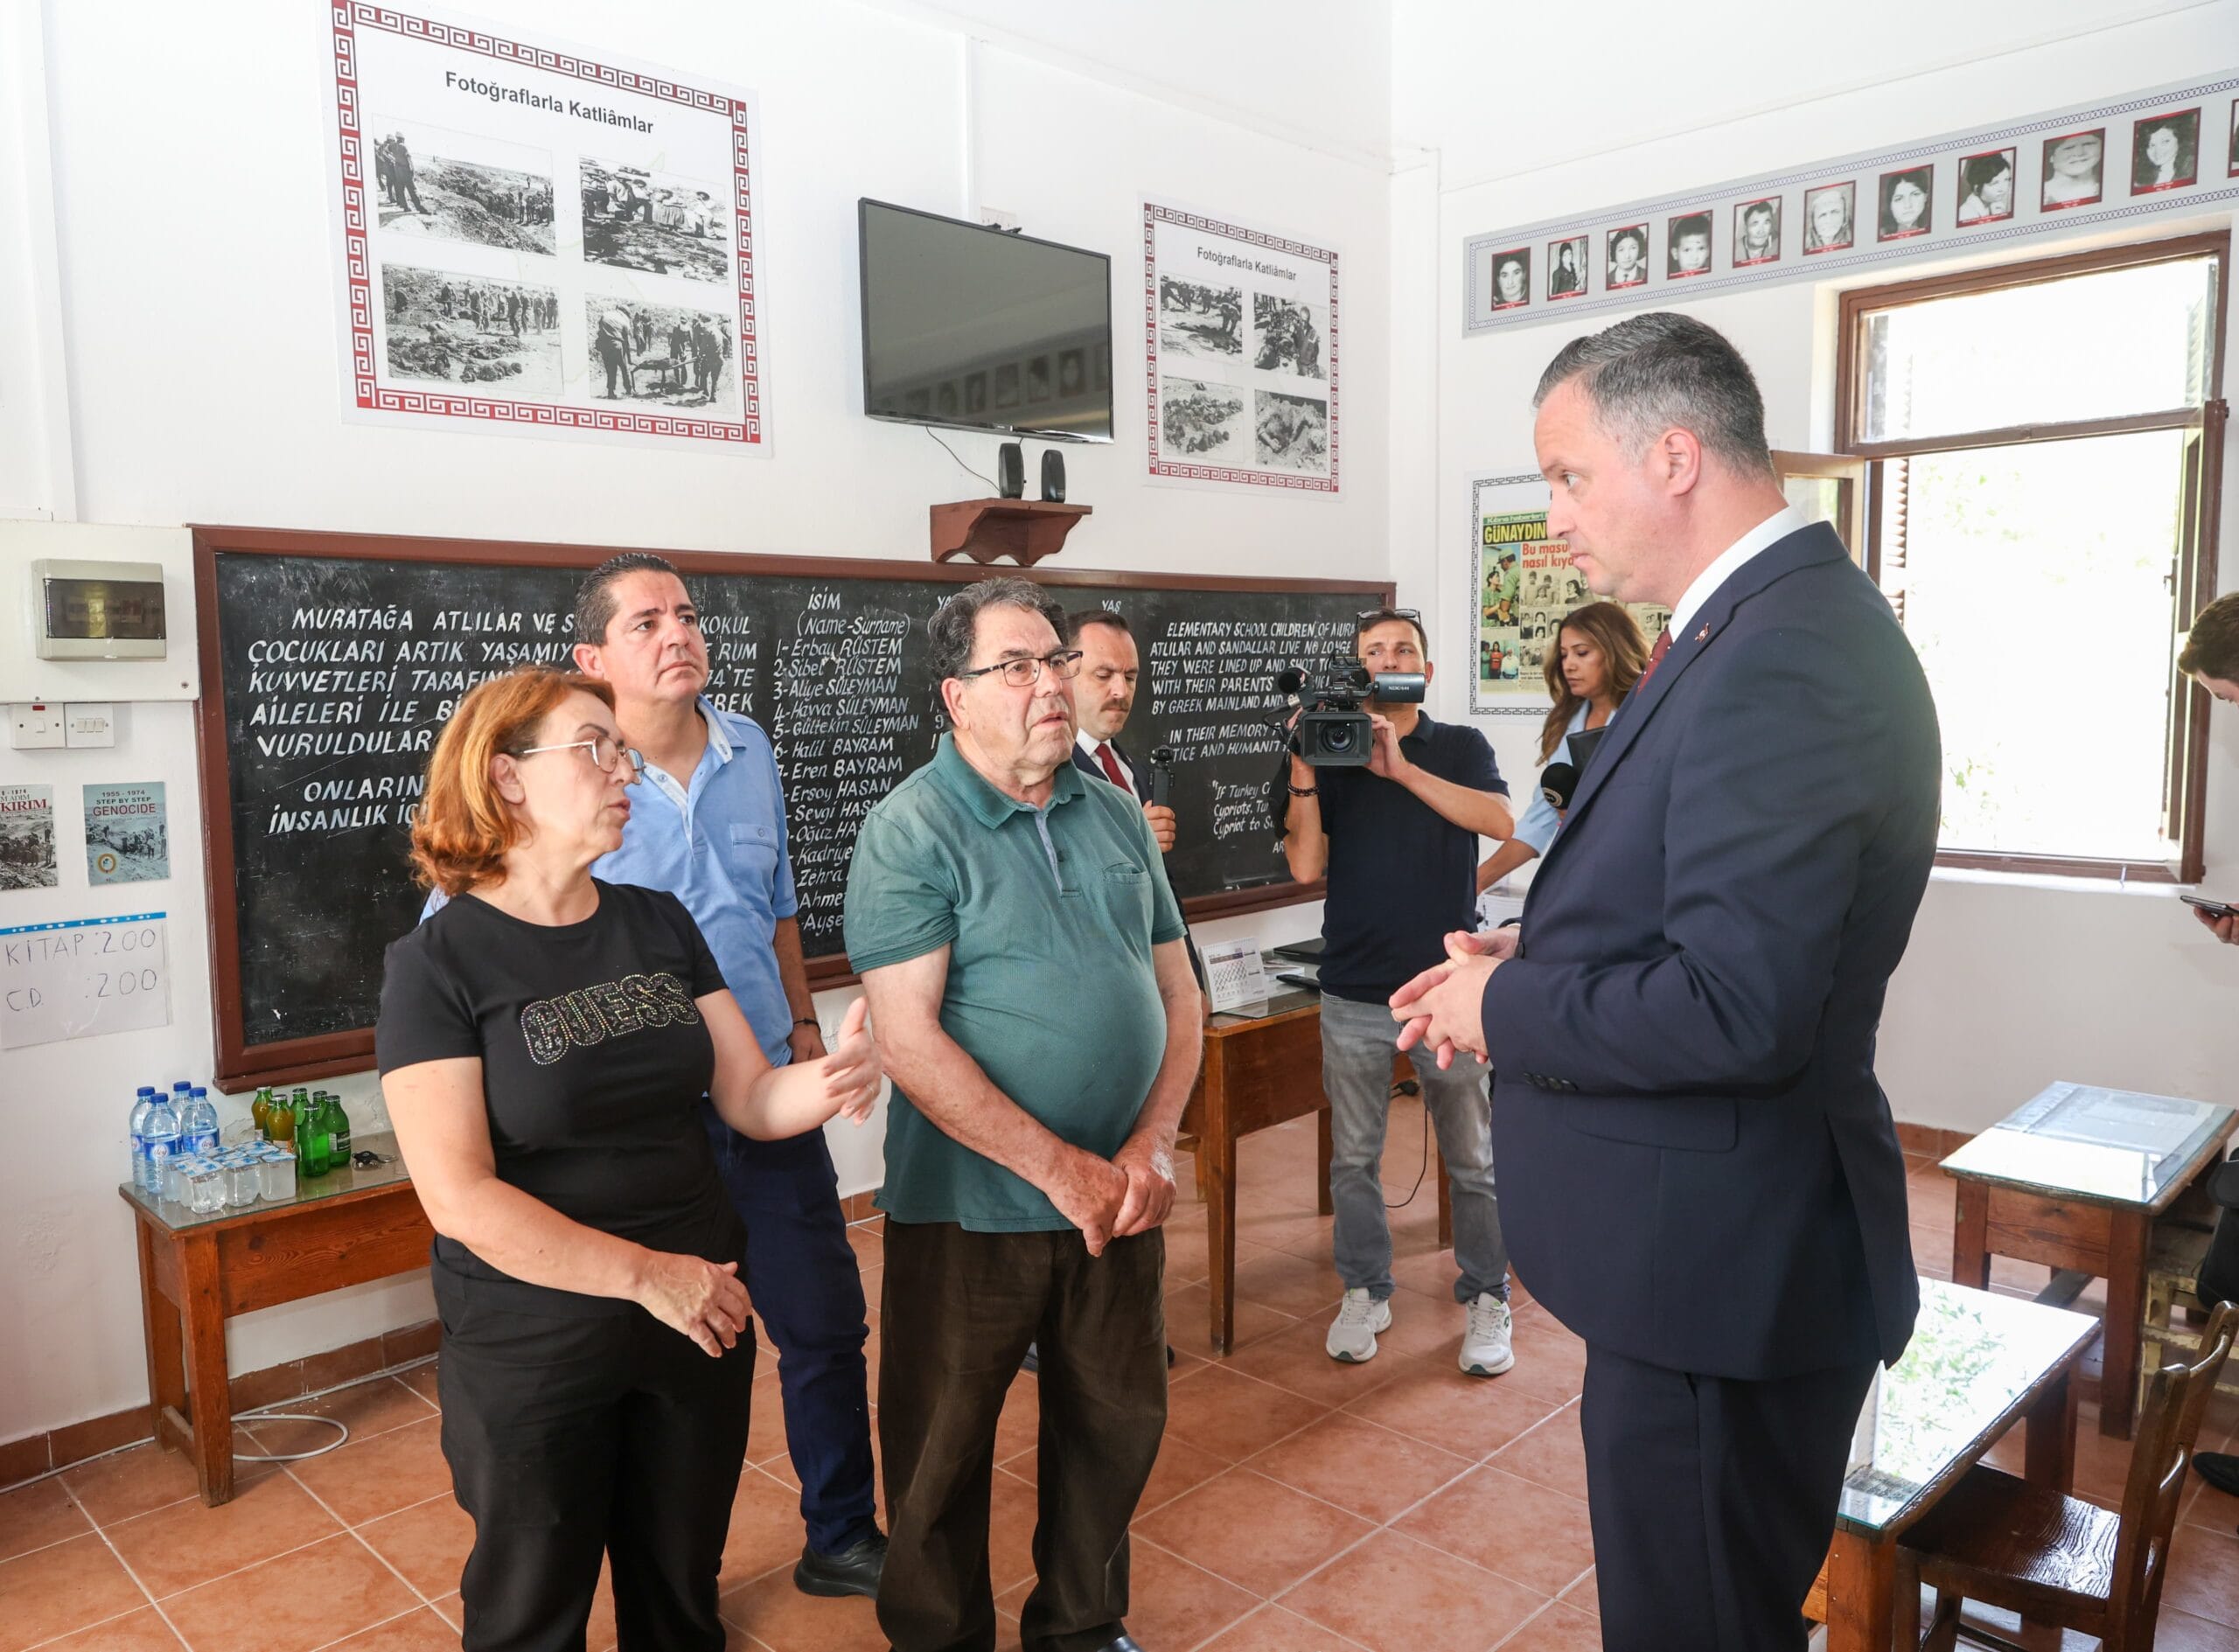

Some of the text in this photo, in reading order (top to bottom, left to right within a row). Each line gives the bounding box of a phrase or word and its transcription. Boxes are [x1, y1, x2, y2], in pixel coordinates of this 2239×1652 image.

[445, 71, 654, 134] Fotoğraflarla Katliâmlar
[1196, 246, 1297, 281] Fotoğraflarla Katliâmlar
[1484, 521, 1546, 543] GÜNAYDIN
[1522, 543, 1568, 555] Bu masu
[1522, 554, 1574, 570] nasıl kıyd
[807, 586, 840, 610] İSİM
[291, 603, 414, 631] MURATAĞA
[433, 611, 522, 633] ATLILAR
[699, 615, 751, 635] KOKUL
[1166, 622, 1232, 638] ELEMENTARY
[1233, 622, 1268, 637] SCHOOL
[1271, 622, 1315, 638] CHILDREN
[248, 638, 385, 671] ÇOCUKLARI
[395, 640, 464, 663] ARTIK
[482, 641, 574, 668] YAŞAMIY
[717, 642, 757, 662] RUM
[840, 635, 903, 656] RÜSTEM
[1149, 640, 1191, 657] ATLILAR
[1195, 640, 1217, 655] AND
[1218, 640, 1276, 655] SANDALLAR
[1279, 640, 1301, 655] LIVE
[835, 654, 902, 677] RÜSTEM
[1150, 660, 1179, 677] THEY
[1182, 659, 1215, 674] WERE
[1218, 659, 1247, 673] LINED
[1249, 659, 1263, 673] UP
[1265, 658, 1286, 672] AND
[248, 664, 398, 694] KUVVETLERİ
[826, 675, 897, 696] SÜLEYMAN
[1152, 676, 1274, 695] WITH THEIR PARENTS
[249, 696, 364, 726] AİLELERİ
[379, 694, 419, 724] İLE
[836, 694, 910, 716] SÜLEYMAN
[1152, 700, 1167, 715] BY
[1168, 698, 1203, 714] GREEK
[1205, 694, 1260, 712] MAINLAND
[1262, 694, 1283, 708] AND
[852, 714, 919, 735] SÜLEYMAN
[1169, 728, 1182, 744] IN
[1186, 726, 1217, 742] THEIR
[1218, 723, 1269, 740] MEMORY
[257, 729, 433, 757] VURULDULAR
[832, 736, 894, 756] BAYRAM
[1200, 743, 1225, 758] AND
[833, 756, 903, 778] BAYRAM
[303, 775, 425, 803] ONLARIN
[836, 777, 892, 798] HASAN
[0, 798, 46, 812] KIRIM
[93, 803, 157, 817] GENOCIDE
[268, 804, 387, 834] İNSANLIK
[799, 890, 847, 910] Ahme
[5, 933, 84, 966] KİTAP
[520, 972, 700, 1065] GUESS
